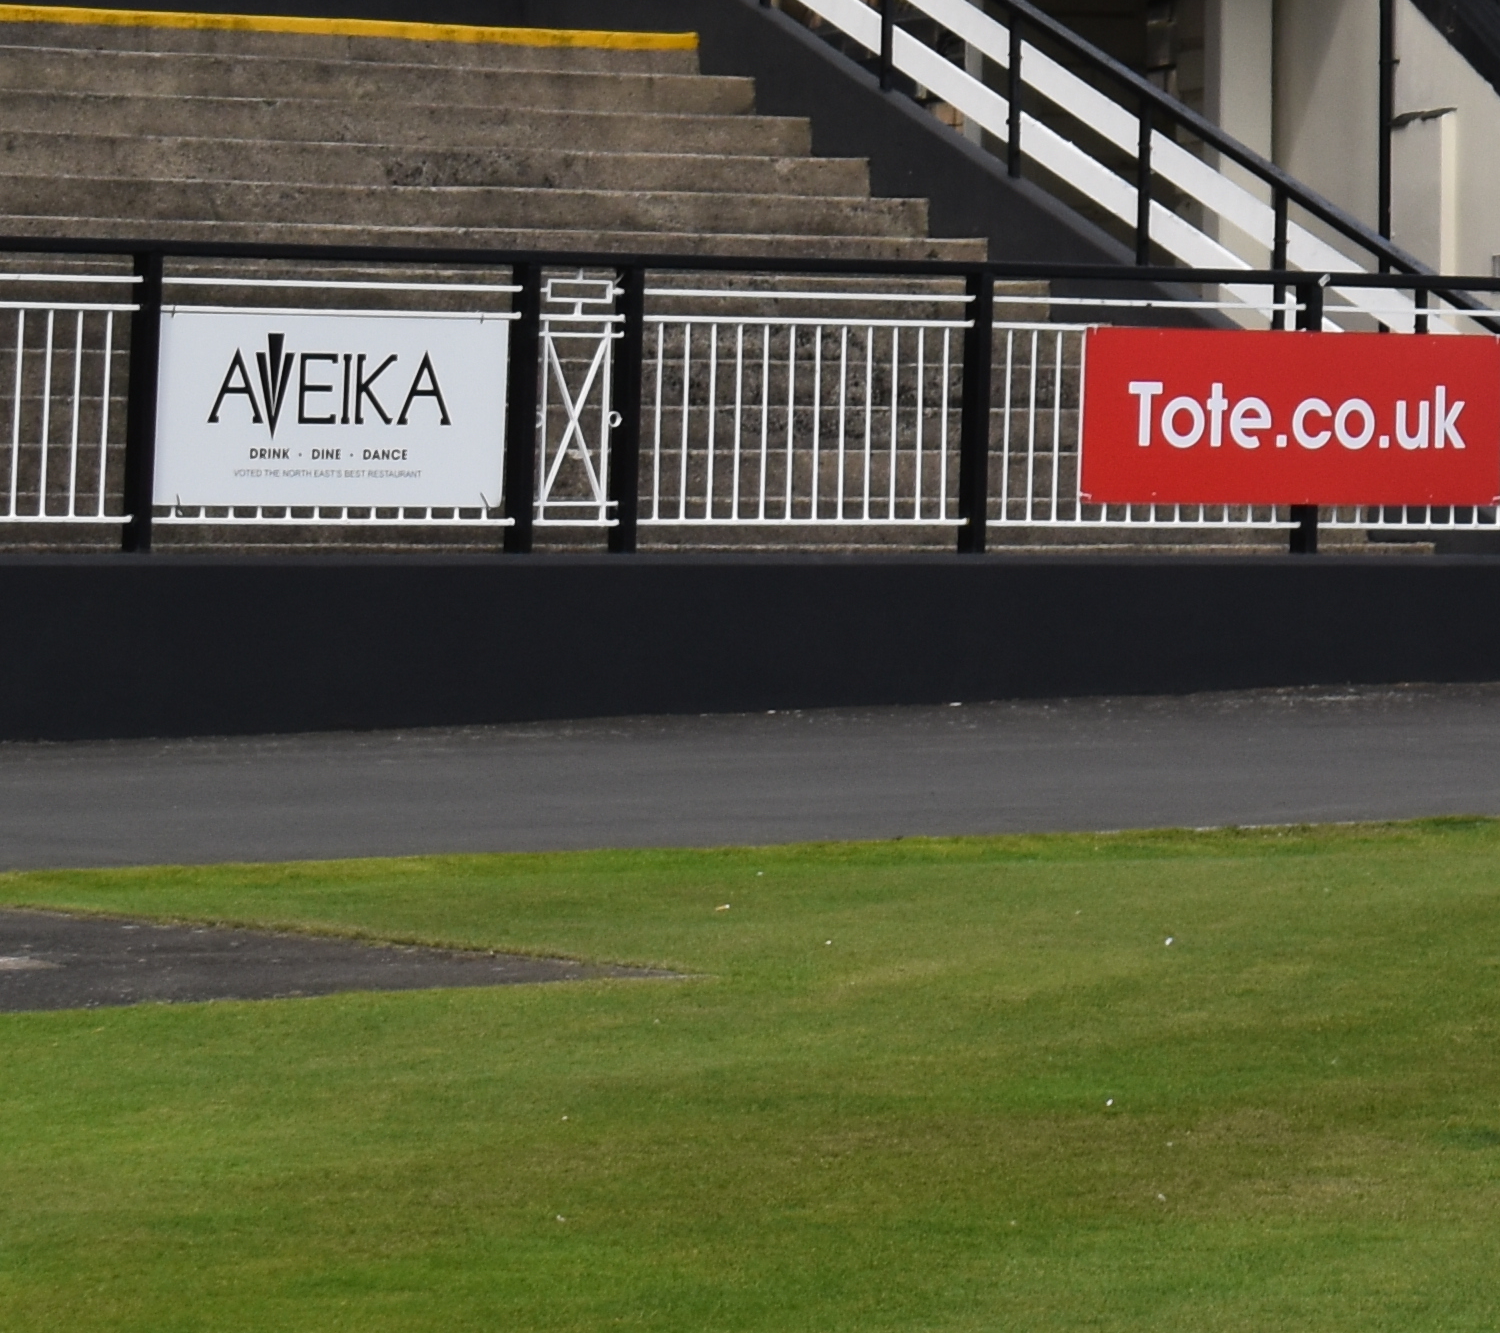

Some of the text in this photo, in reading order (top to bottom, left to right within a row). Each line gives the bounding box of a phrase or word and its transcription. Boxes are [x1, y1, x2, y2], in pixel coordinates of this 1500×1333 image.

[206, 332, 453, 440] AVEIKA
[1128, 381, 1467, 450] Tote.co.uk
[233, 468, 263, 478] VOTED
[264, 468, 280, 478] THE
[282, 469, 313, 479] NORTH
[344, 469, 366, 479] BEST
[249, 448, 408, 461] DRINK DINE DANCE
